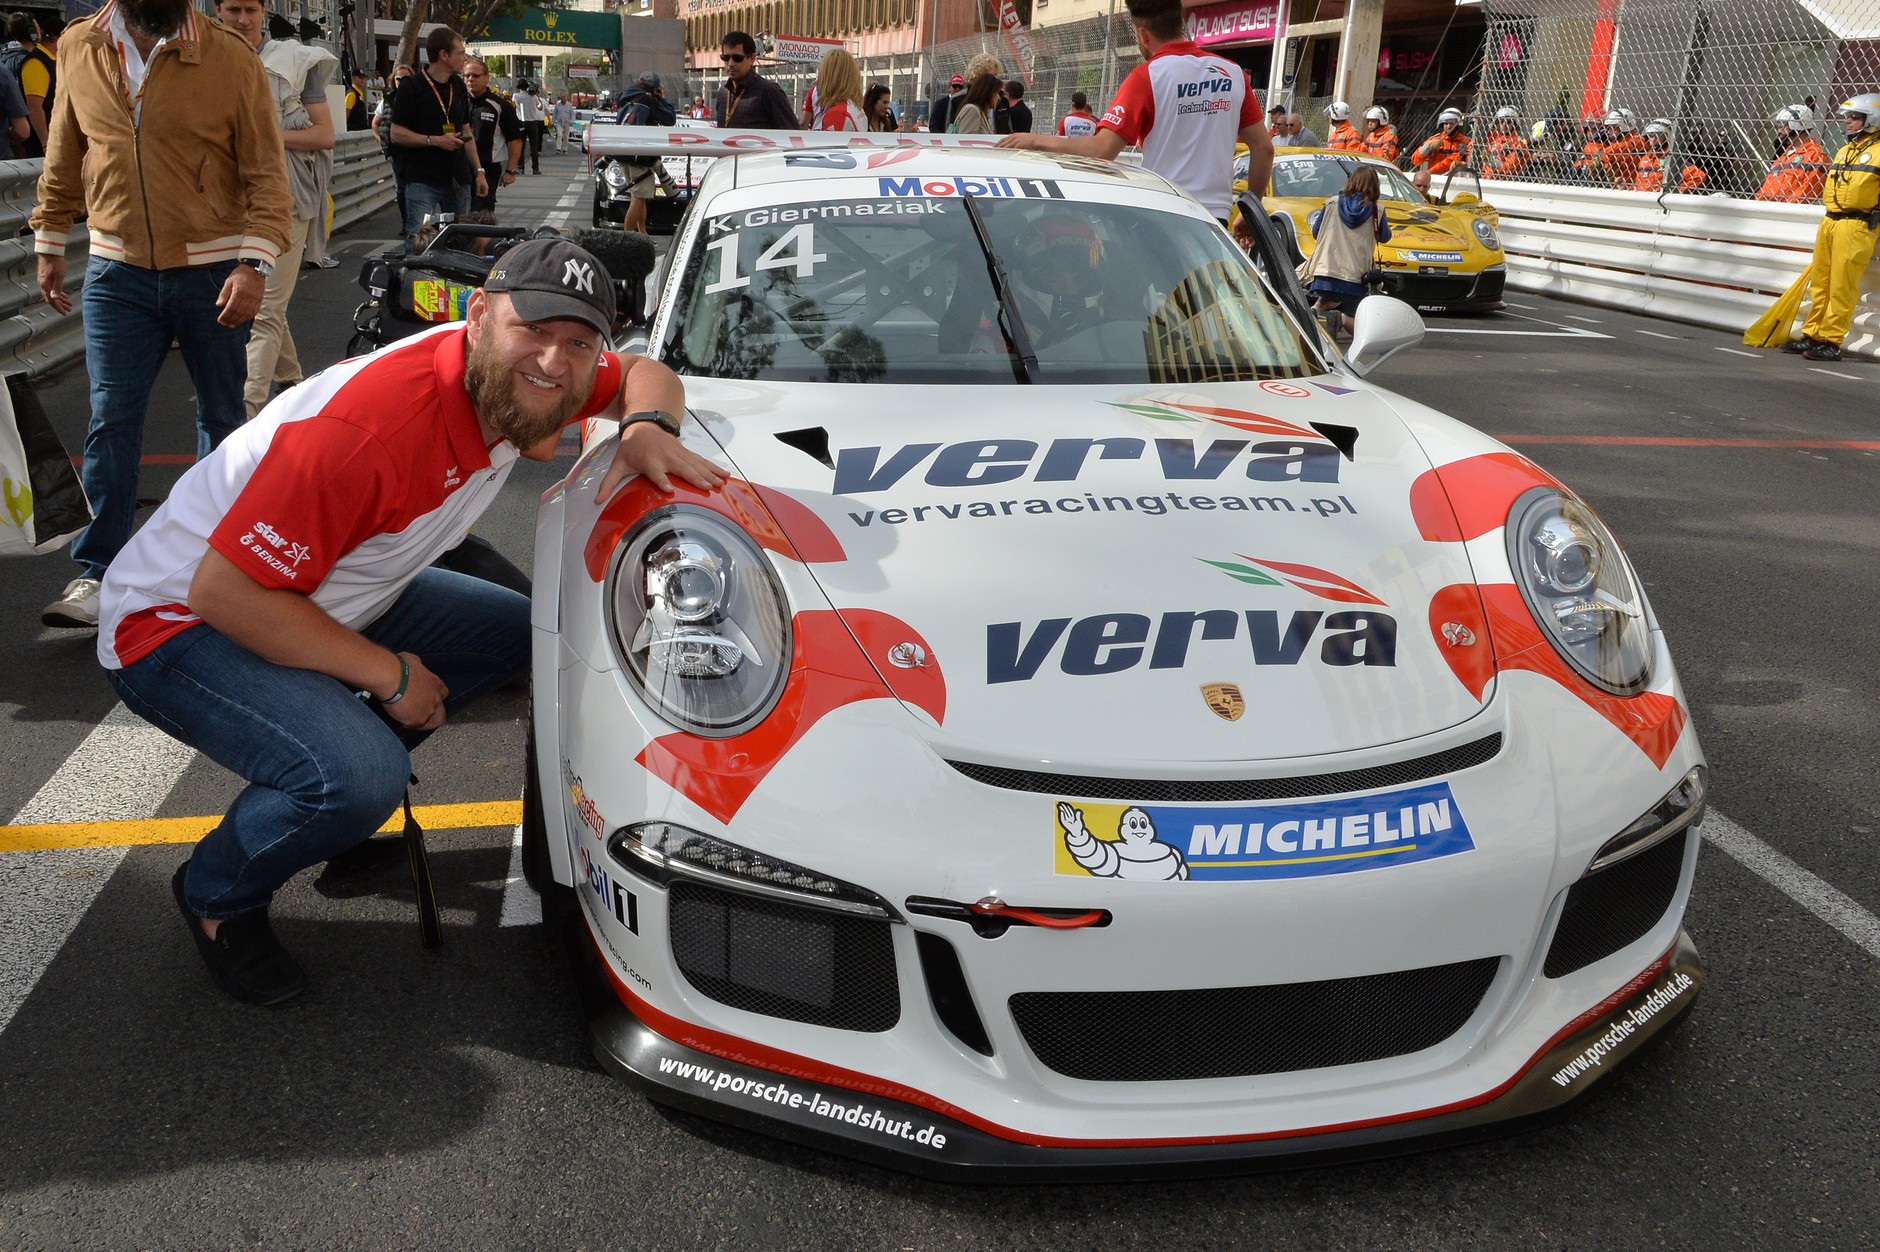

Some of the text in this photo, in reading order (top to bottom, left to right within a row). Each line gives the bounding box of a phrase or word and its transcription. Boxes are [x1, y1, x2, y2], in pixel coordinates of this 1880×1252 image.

[524, 28, 577, 44] ROLEX
[1196, 4, 1281, 37] PLANET SUSH
[778, 42, 820, 53] MONACO
[1177, 78, 1232, 98] verva
[1283, 166, 1319, 184] 12
[1293, 160, 1314, 168] Eng
[878, 177, 1056, 198] Mobil 1
[704, 222, 827, 294] 14
[562, 258, 595, 295] NY
[832, 436, 1340, 495] verva
[847, 491, 1358, 527] vervaracingteam.pl
[253, 521, 288, 549] star
[250, 544, 298, 579] BENZINA
[986, 609, 1397, 684] verva
[1188, 797, 1453, 856] MICHELIN
[1551, 971, 1693, 1087] www.porsche-landshut.de
[658, 1055, 947, 1150] www.porsche-landshut.de
